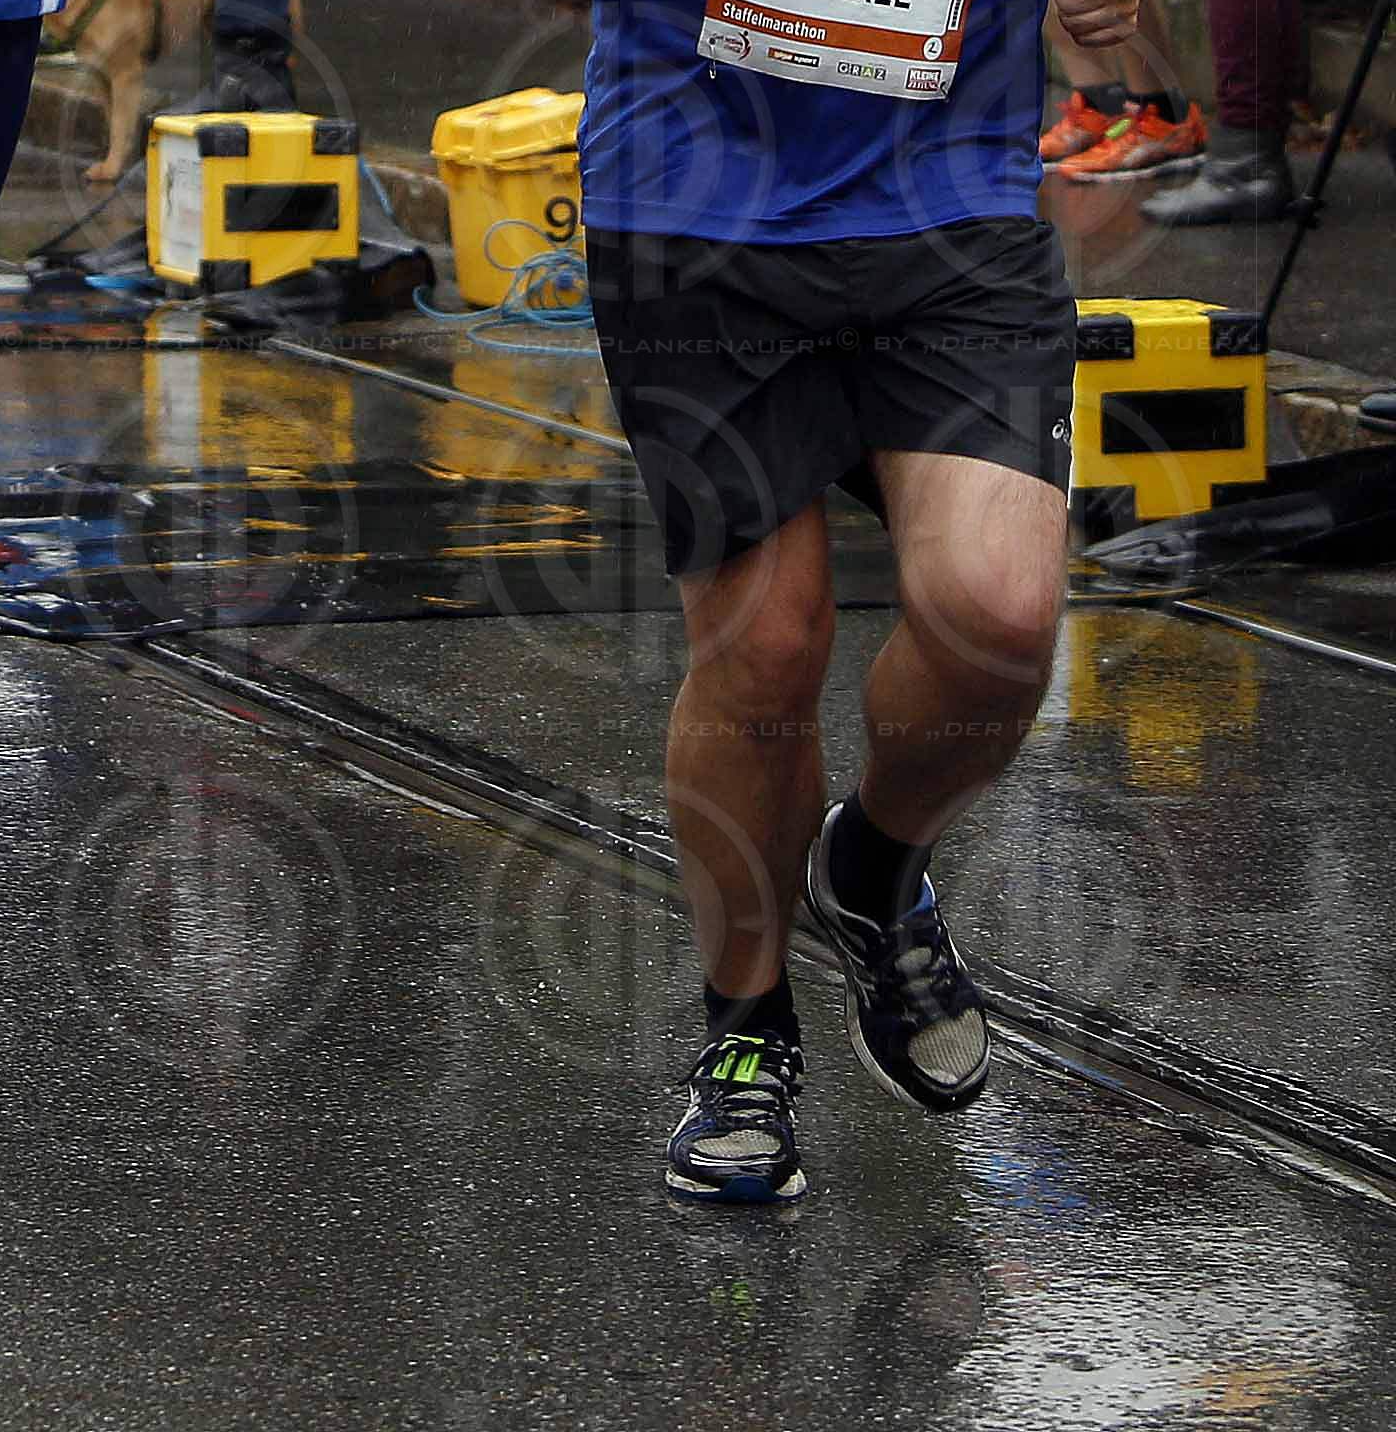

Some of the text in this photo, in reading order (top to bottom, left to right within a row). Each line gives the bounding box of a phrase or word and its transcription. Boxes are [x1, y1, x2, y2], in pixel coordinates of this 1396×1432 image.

[722, 2, 827, 41] Staffelmarathon
[837, 62, 887, 80] GRAZ
[545, 196, 577, 242] 9
